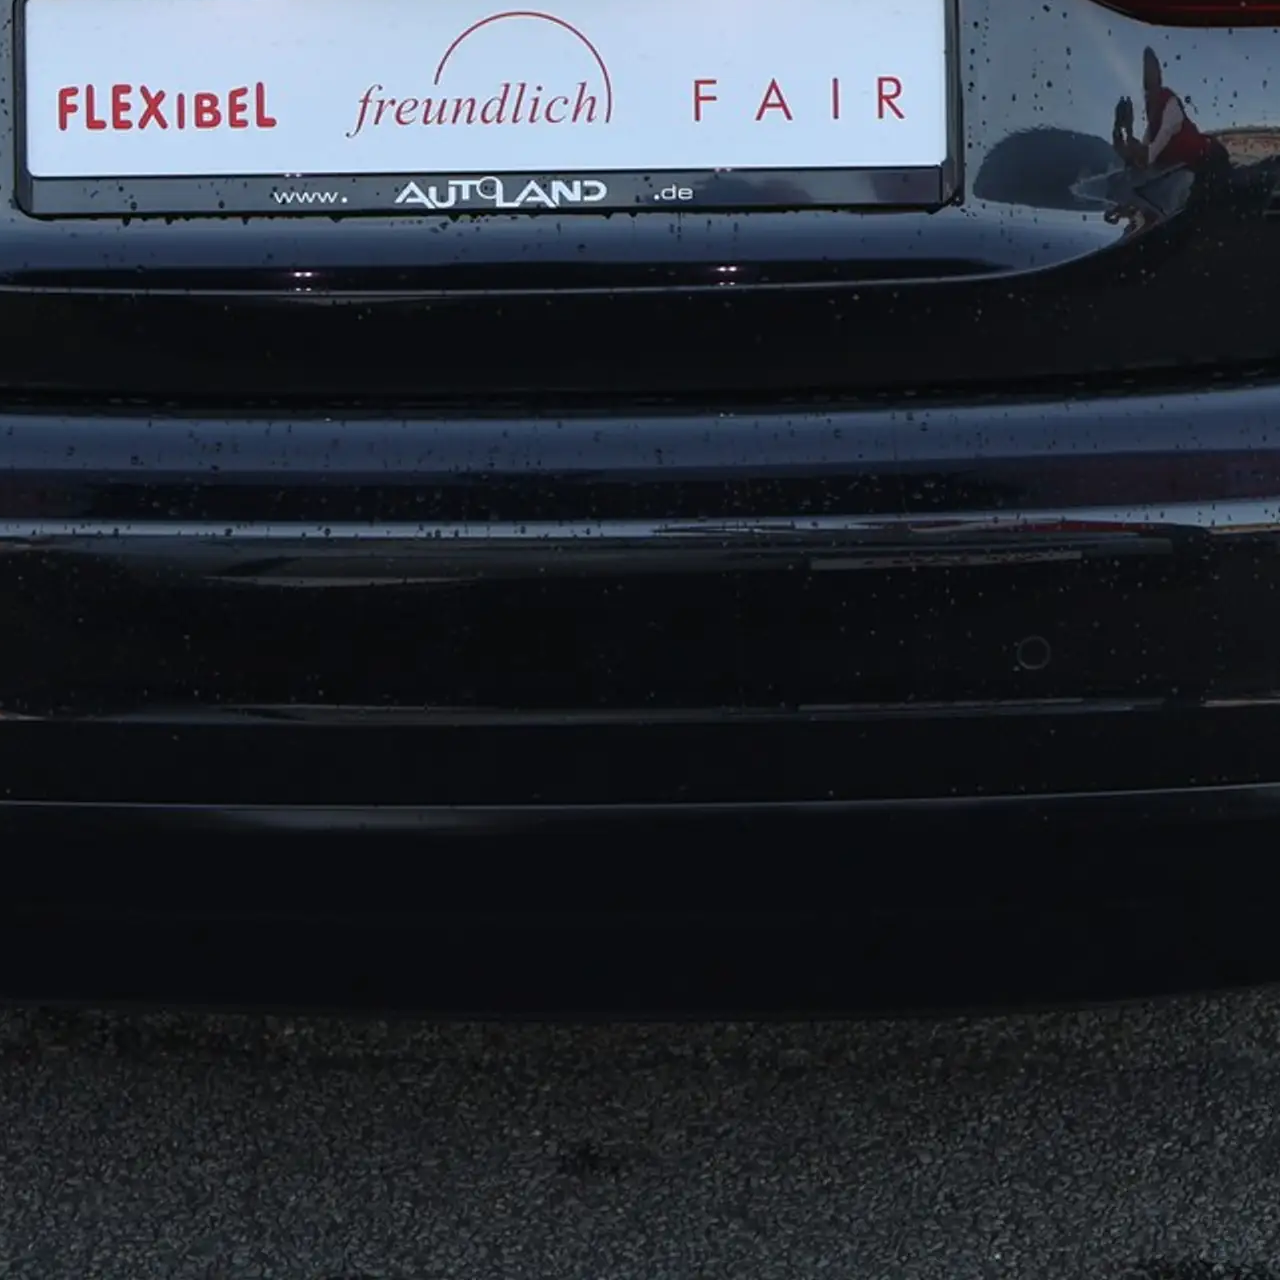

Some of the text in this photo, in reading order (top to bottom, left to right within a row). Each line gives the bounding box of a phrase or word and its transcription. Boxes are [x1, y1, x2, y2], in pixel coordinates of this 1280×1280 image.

[57, 81, 277, 131] FLEXIBEL
[345, 81, 600, 138] freundlich
[273, 187, 349, 204] www.
[394, 175, 608, 208] AUTOLAND
